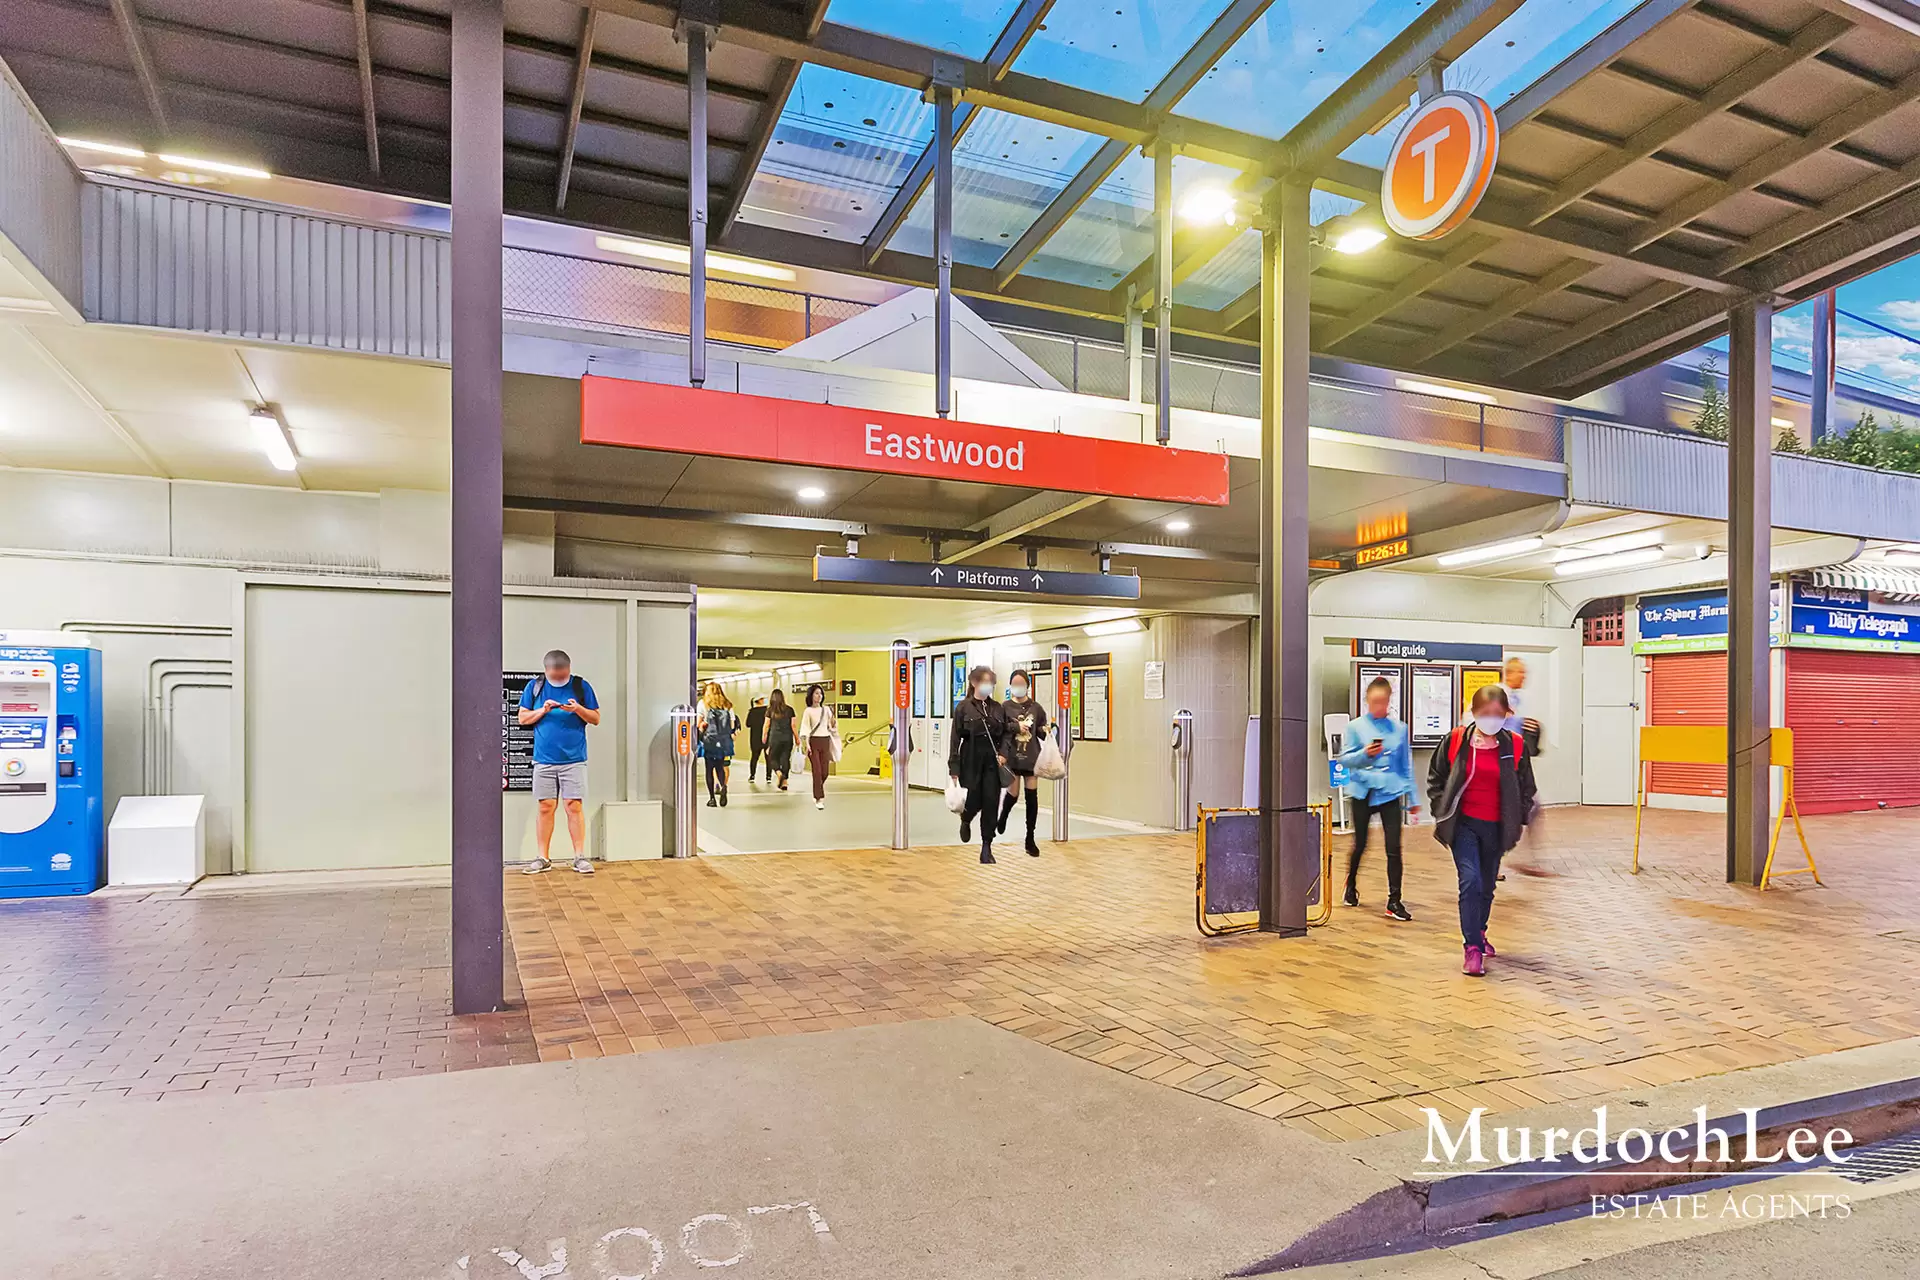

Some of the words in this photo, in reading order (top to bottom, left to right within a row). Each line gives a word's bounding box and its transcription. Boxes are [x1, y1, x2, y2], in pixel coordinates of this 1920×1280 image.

[1411, 125, 1451, 204] T
[865, 423, 1025, 471] Eastwood
[1357, 540, 1408, 565] 17:26:14
[957, 570, 1019, 587] Platforms
[1644, 609, 1662, 623] The
[1663, 607, 1697, 622] Sydney
[1698, 604, 1728, 620] Morni
[1828, 612, 1858, 633] Daily
[1858, 615, 1909, 637] Telegraph
[1376, 643, 1400, 655] Local
[1401, 645, 1427, 657] guide
[845, 683, 853, 693] 3
